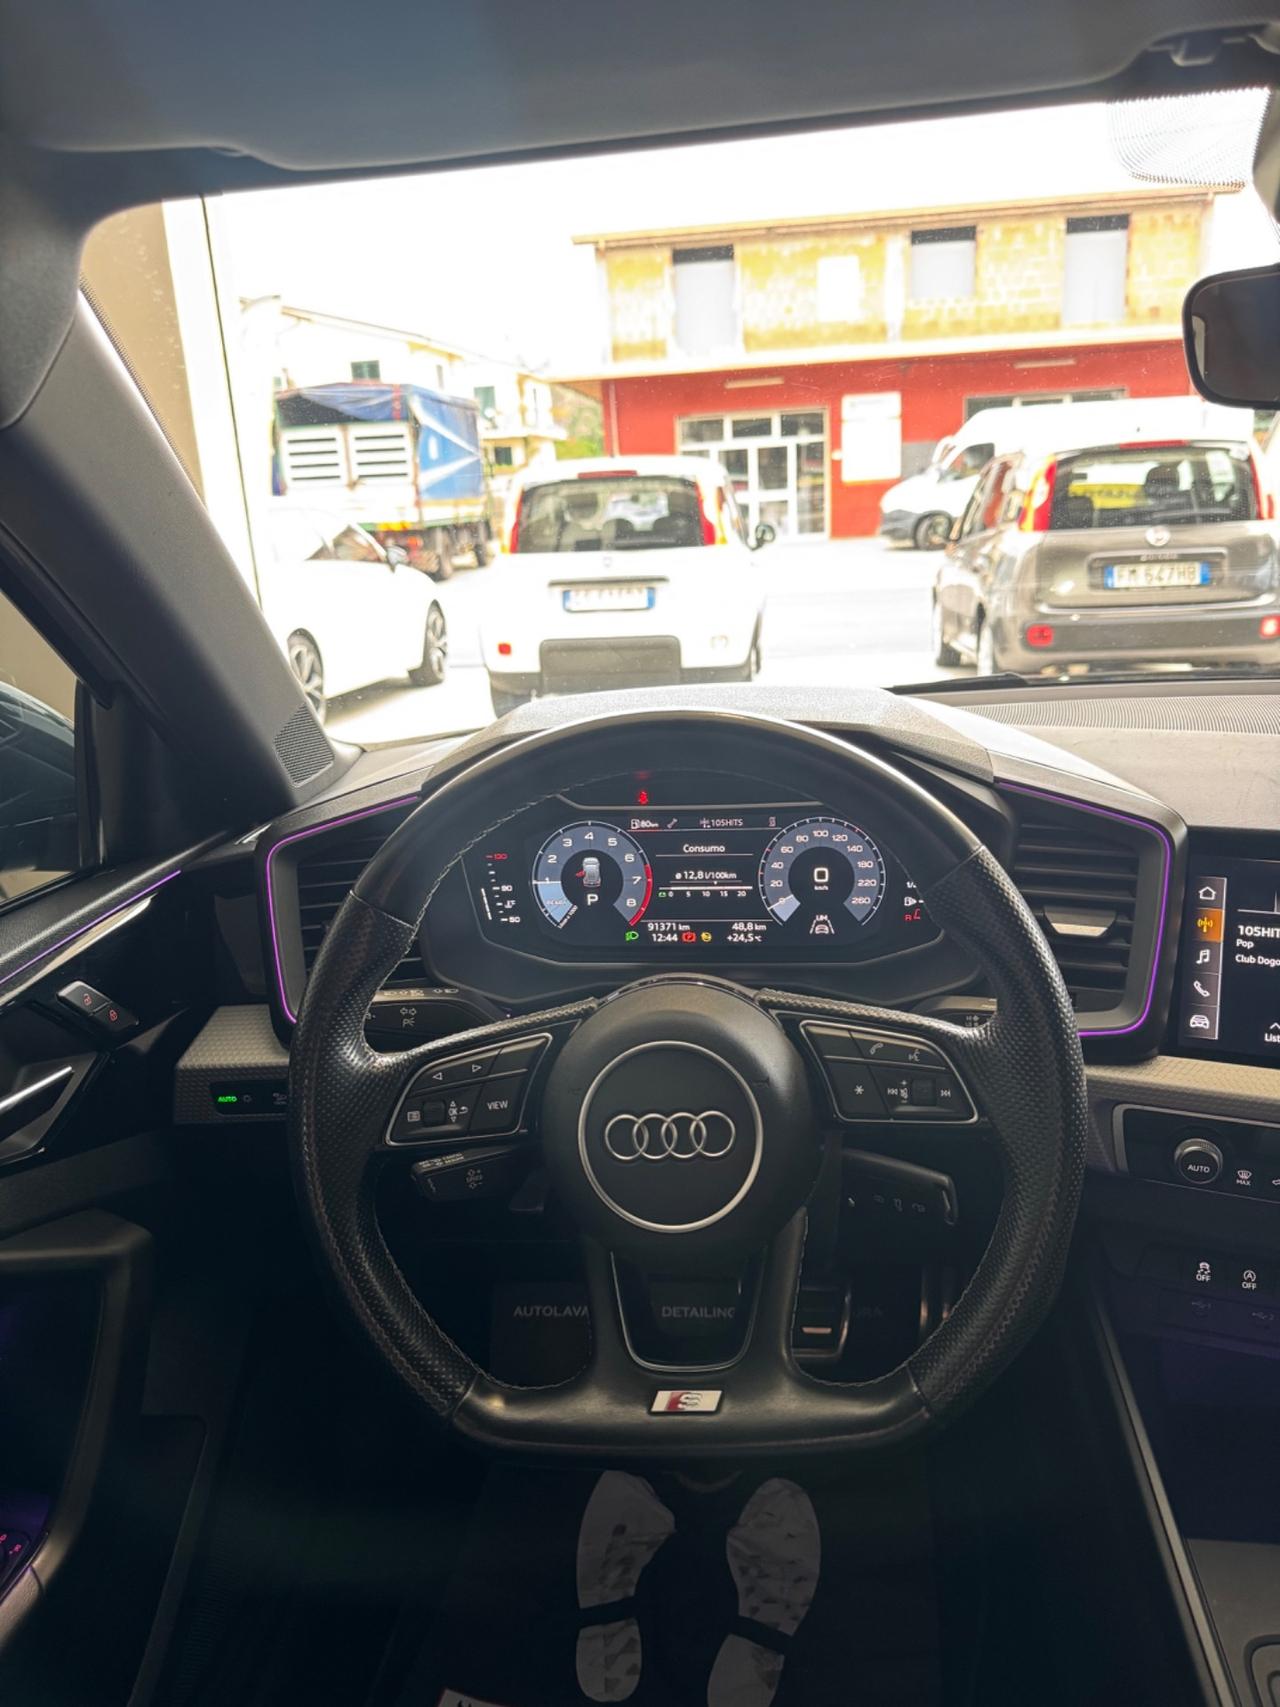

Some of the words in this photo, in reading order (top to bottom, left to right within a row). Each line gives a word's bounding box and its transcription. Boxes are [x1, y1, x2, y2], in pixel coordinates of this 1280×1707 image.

[711, 818, 744, 827] 105HITS
[584, 832, 594, 840] 4
[812, 830, 829, 838] 100
[832, 834, 848, 842] 120
[563, 838, 573, 847] 3
[608, 838, 618, 846] 5
[796, 835, 809, 843] 80
[683, 844, 726, 853] Consumo
[780, 846, 794, 854] 60
[846, 845, 864, 853] 140
[548, 855, 557, 863] 2
[624, 854, 634, 862] 6
[857, 860, 874, 868] 180
[684, 871, 704, 880] 12,8
[813, 867, 829, 883] 0
[632, 876, 642, 884] 7
[770, 880, 783, 888] 20
[857, 879, 877, 887] 220
[587, 894, 599, 905] P
[626, 899, 636, 907] 8
[851, 897, 871, 905] 260
[647, 922, 677, 932] 91371
[678, 922, 691, 931] km
[731, 922, 754, 932] 48,8
[754, 922, 767, 931] km
[651, 933, 679, 942] 12:44
[1236, 938, 1255, 950] Pop
[1235, 953, 1257, 964] Club
[1257, 955, 1280, 967] Dogo
[486, 1100, 509, 1111] VIEW
[1187, 1164, 1210, 1174] AUTO
[1236, 1178, 1251, 1186] MAX
[1196, 1273, 1211, 1282] OFF
[1242, 1281, 1257, 1290] OFF
